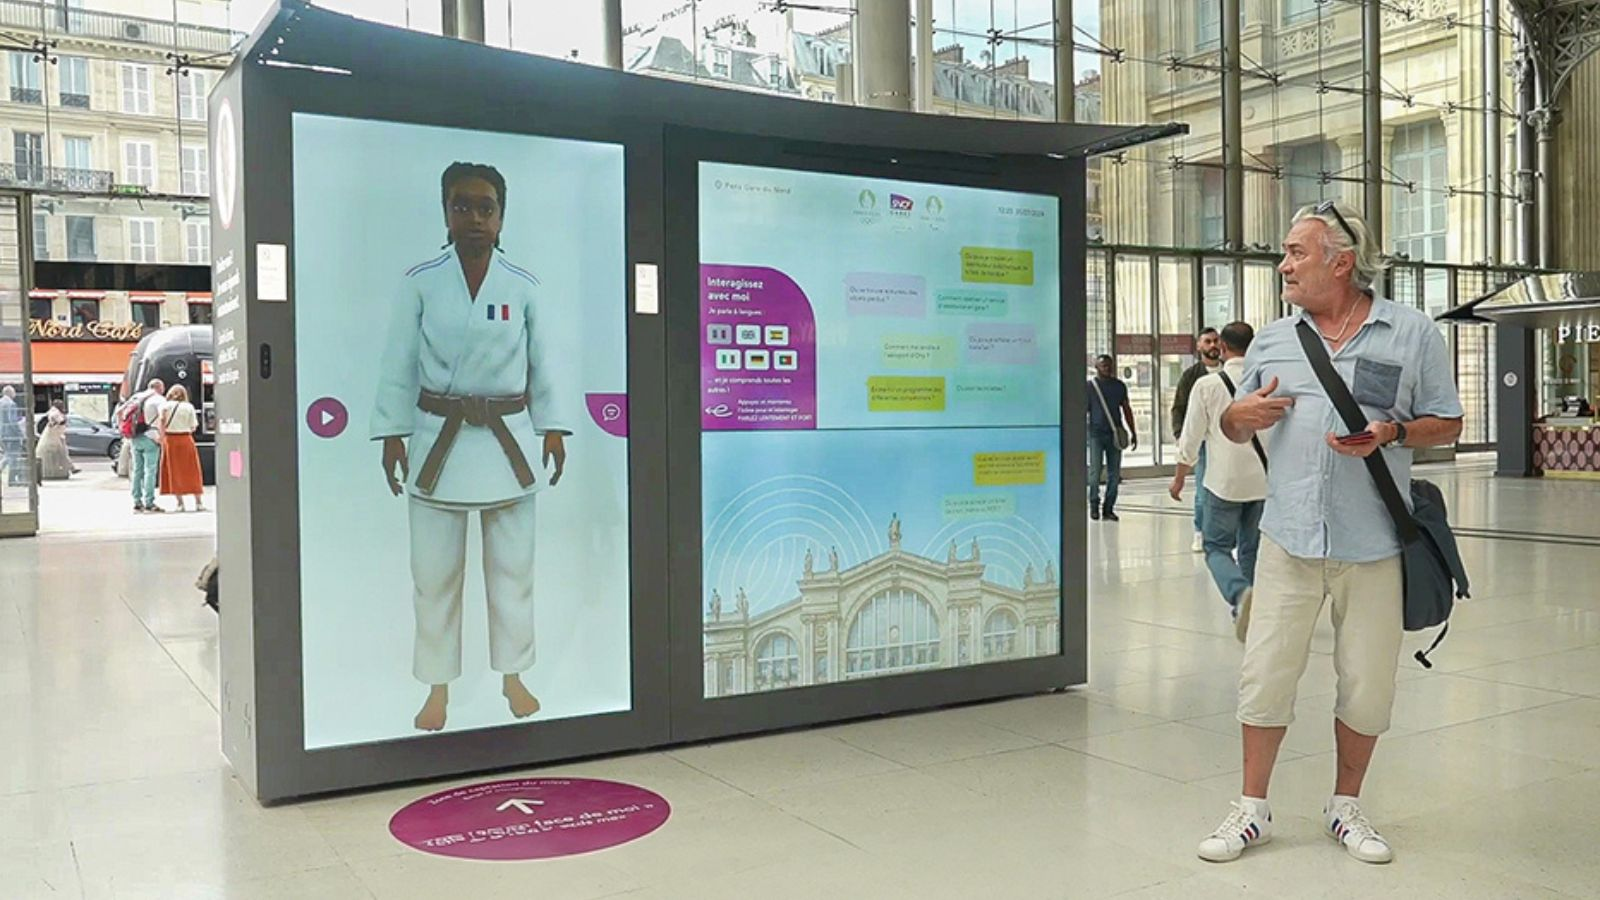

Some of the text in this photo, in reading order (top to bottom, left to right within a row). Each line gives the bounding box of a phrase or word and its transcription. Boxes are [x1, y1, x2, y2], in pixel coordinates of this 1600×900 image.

[707, 276, 764, 290] Interagissez
[707, 291, 750, 301] avec moi
[28, 319, 144, 341] Nord Café
[1558, 326, 1600, 344] PIE
